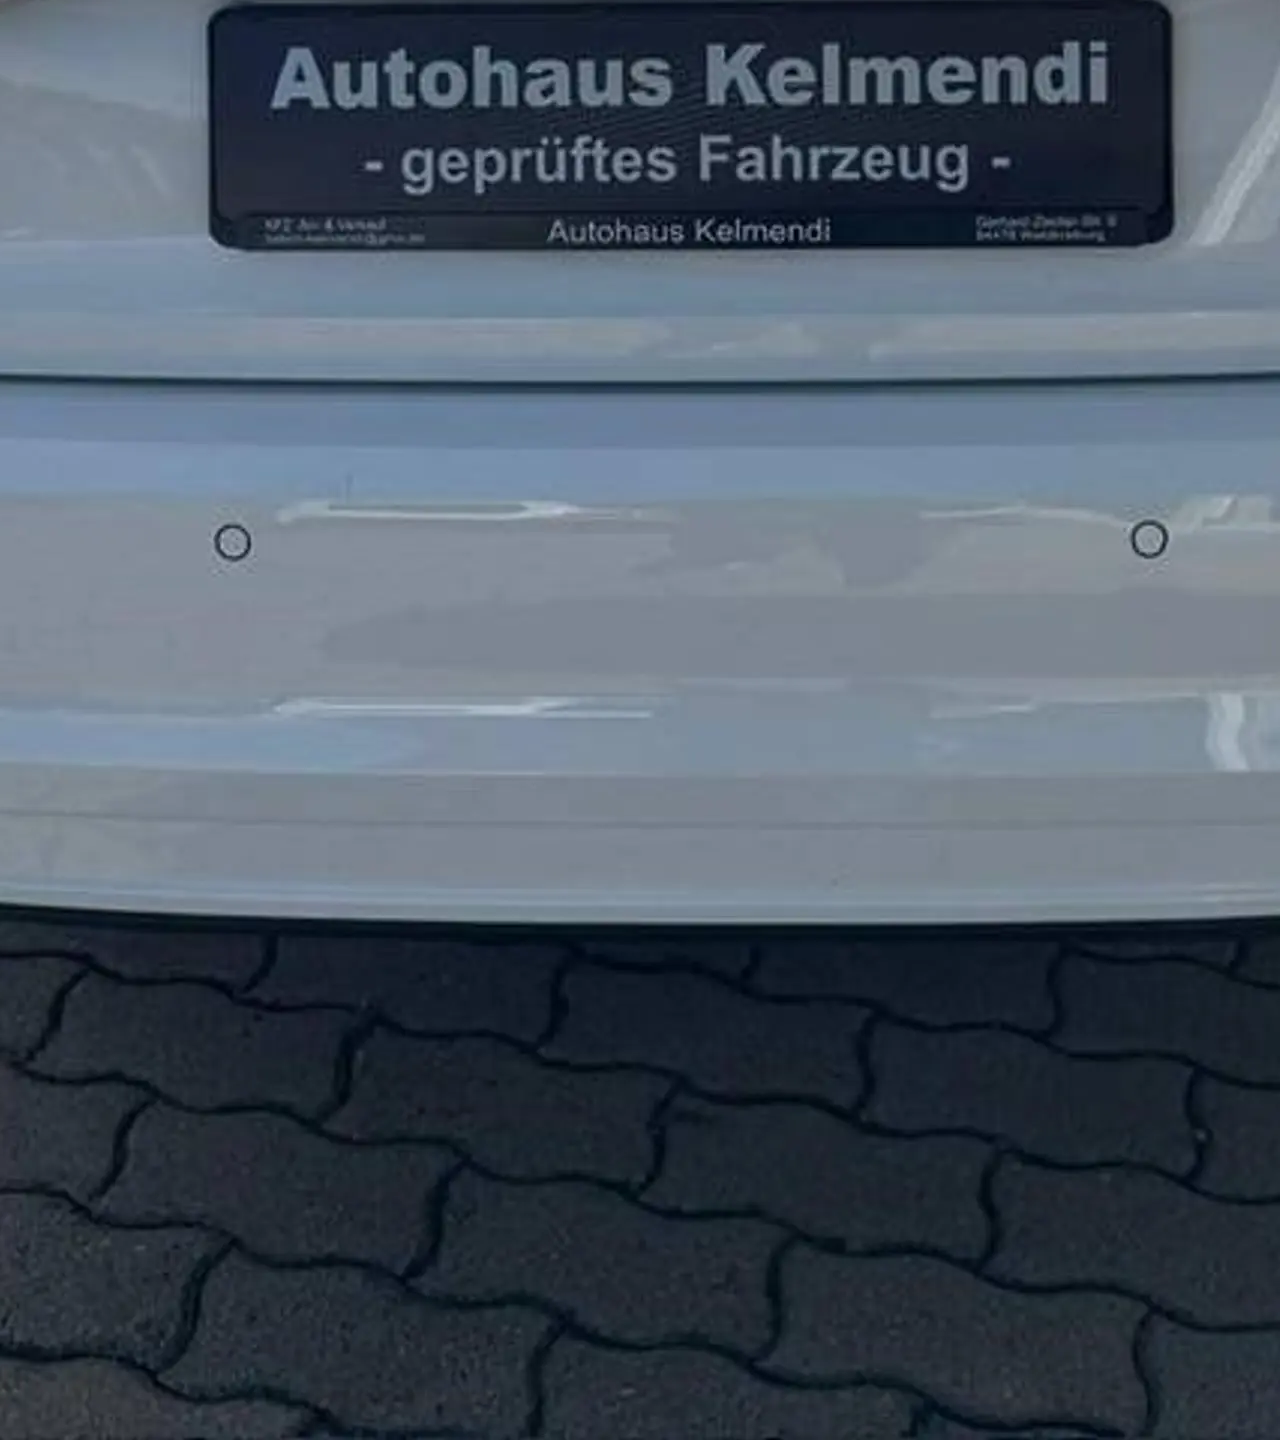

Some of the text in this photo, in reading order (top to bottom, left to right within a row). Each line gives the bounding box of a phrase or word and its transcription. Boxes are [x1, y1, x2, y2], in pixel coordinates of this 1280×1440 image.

[270, 40, 1108, 109] Autohaus Kelmendi
[401, 134, 678, 196] geprüftes
[699, 133, 970, 193] Fahrzeug
[547, 216, 832, 244] Autohaus Kelmendi
